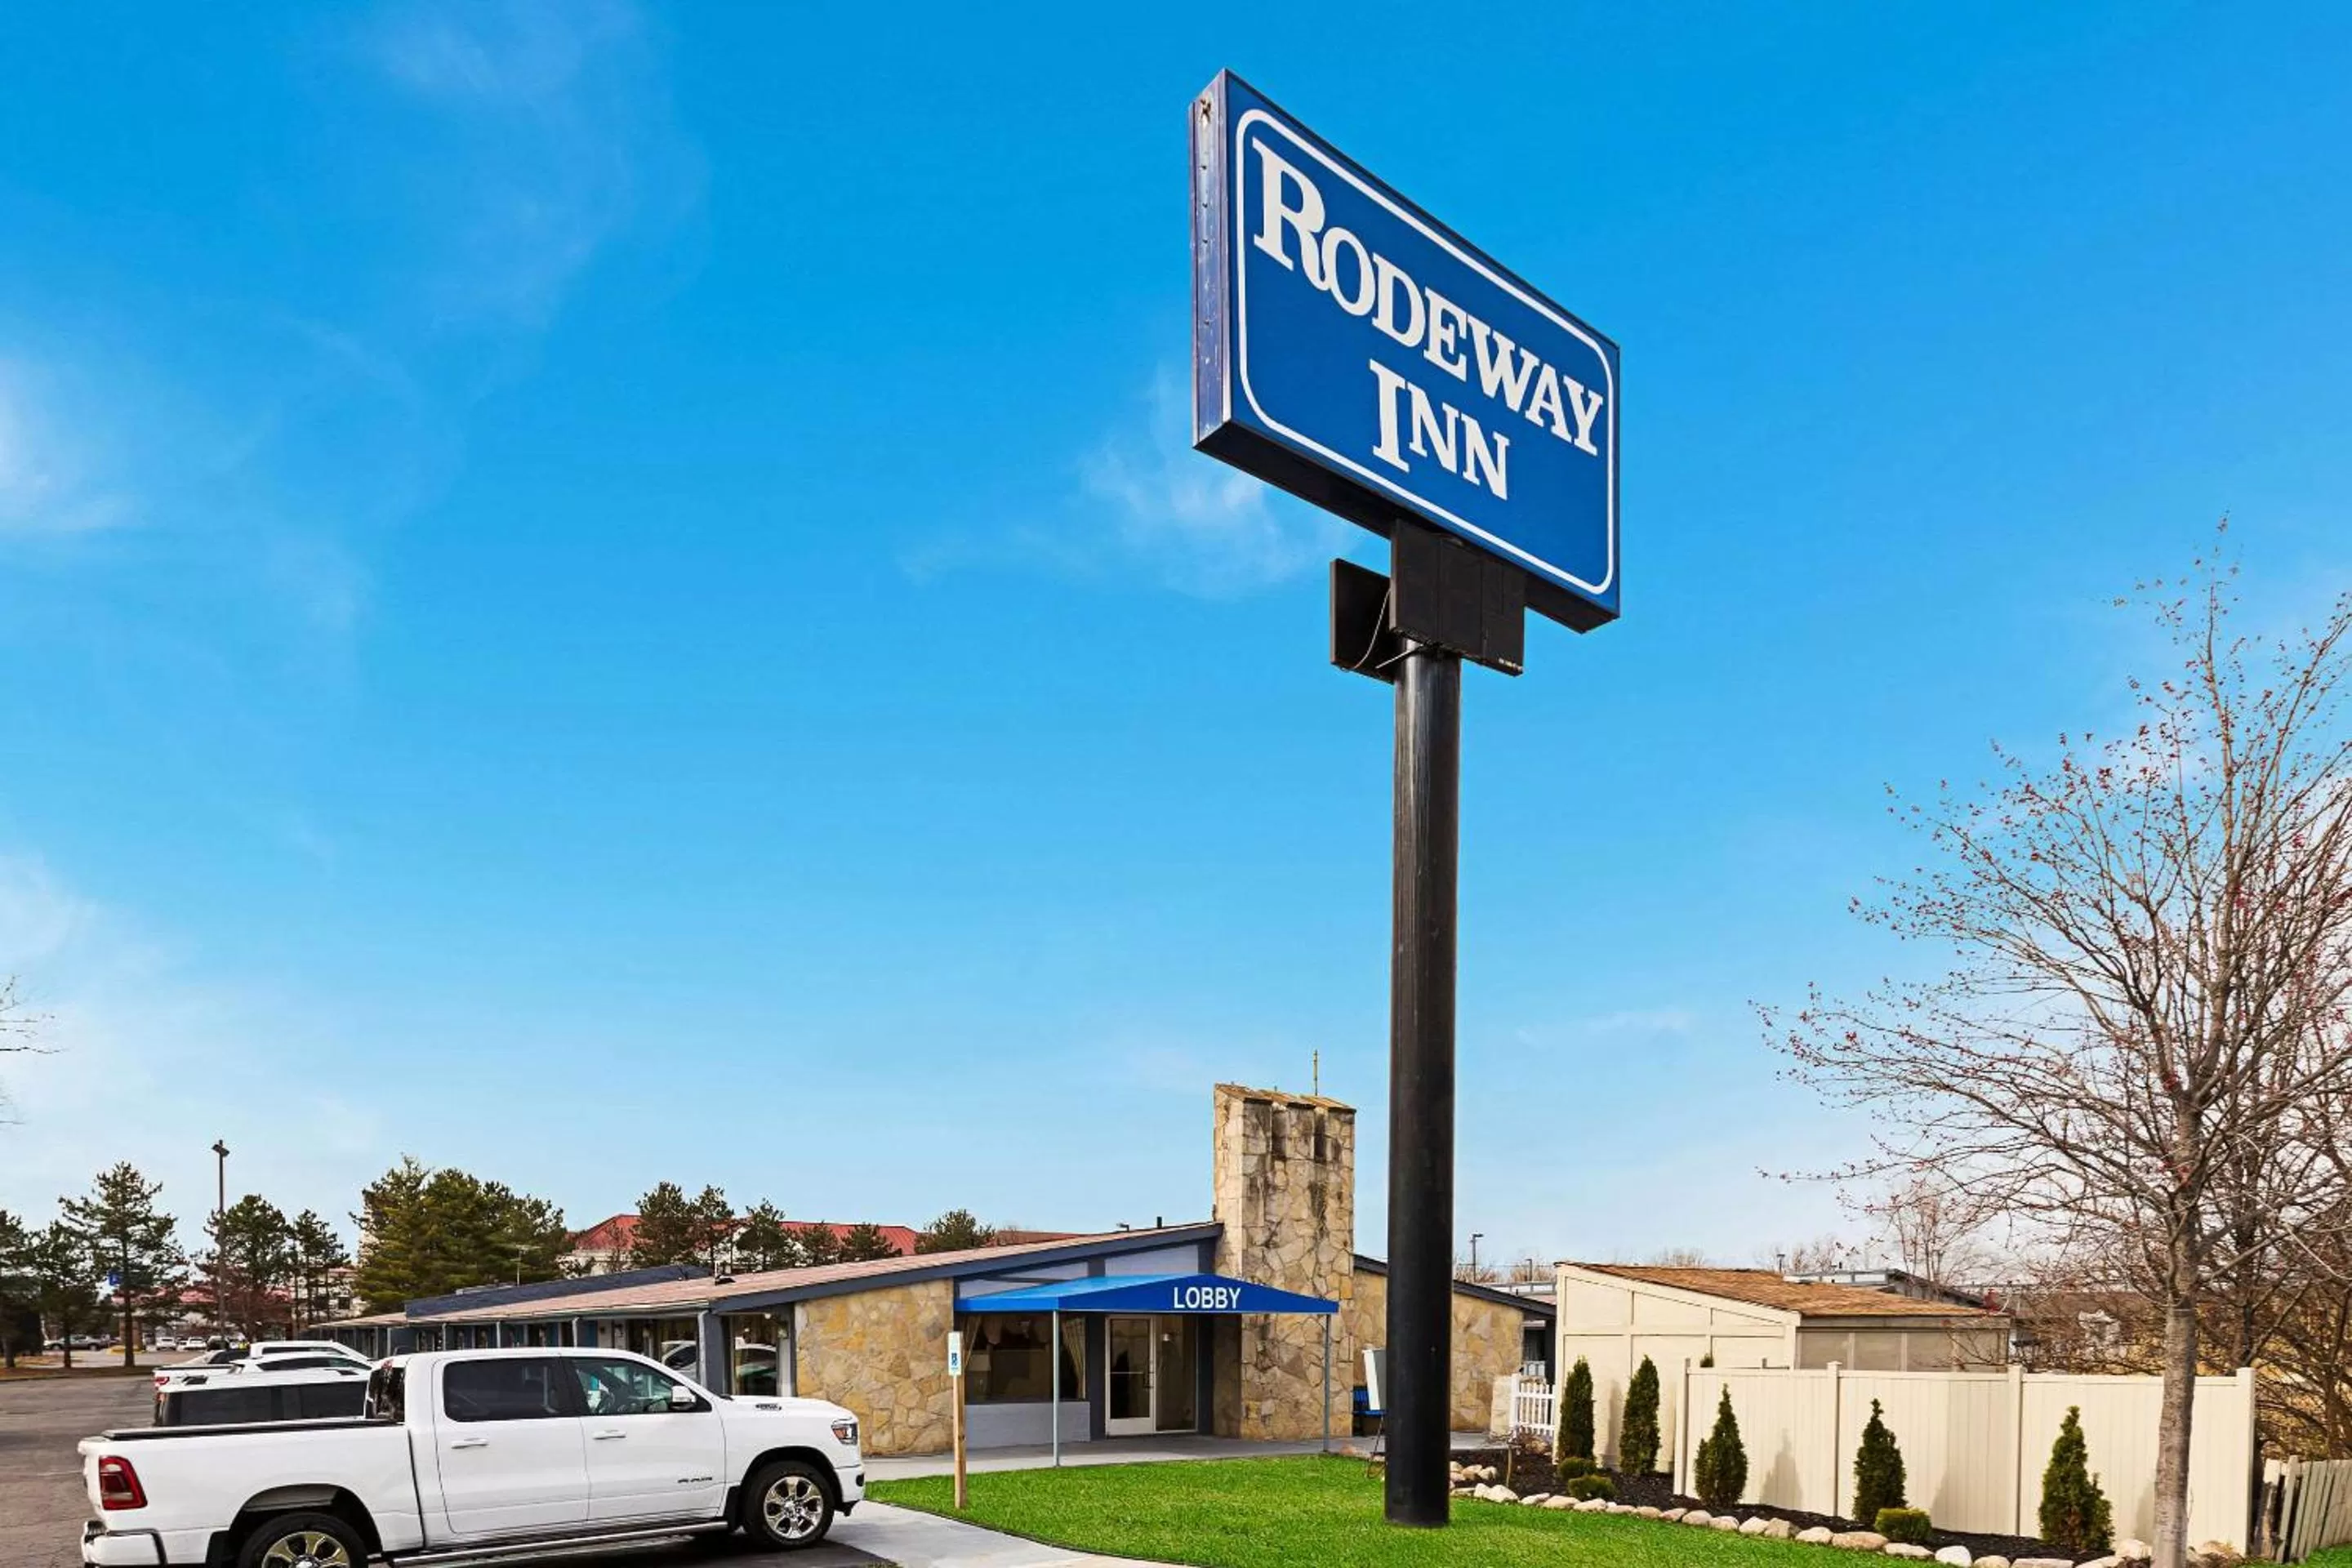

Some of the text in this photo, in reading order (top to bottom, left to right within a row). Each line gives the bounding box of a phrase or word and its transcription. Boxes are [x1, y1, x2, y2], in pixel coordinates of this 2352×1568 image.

[1252, 136, 1603, 456] RODEWAY
[1370, 359, 1510, 501] INN
[1174, 1286, 1241, 1309] LOBBY
